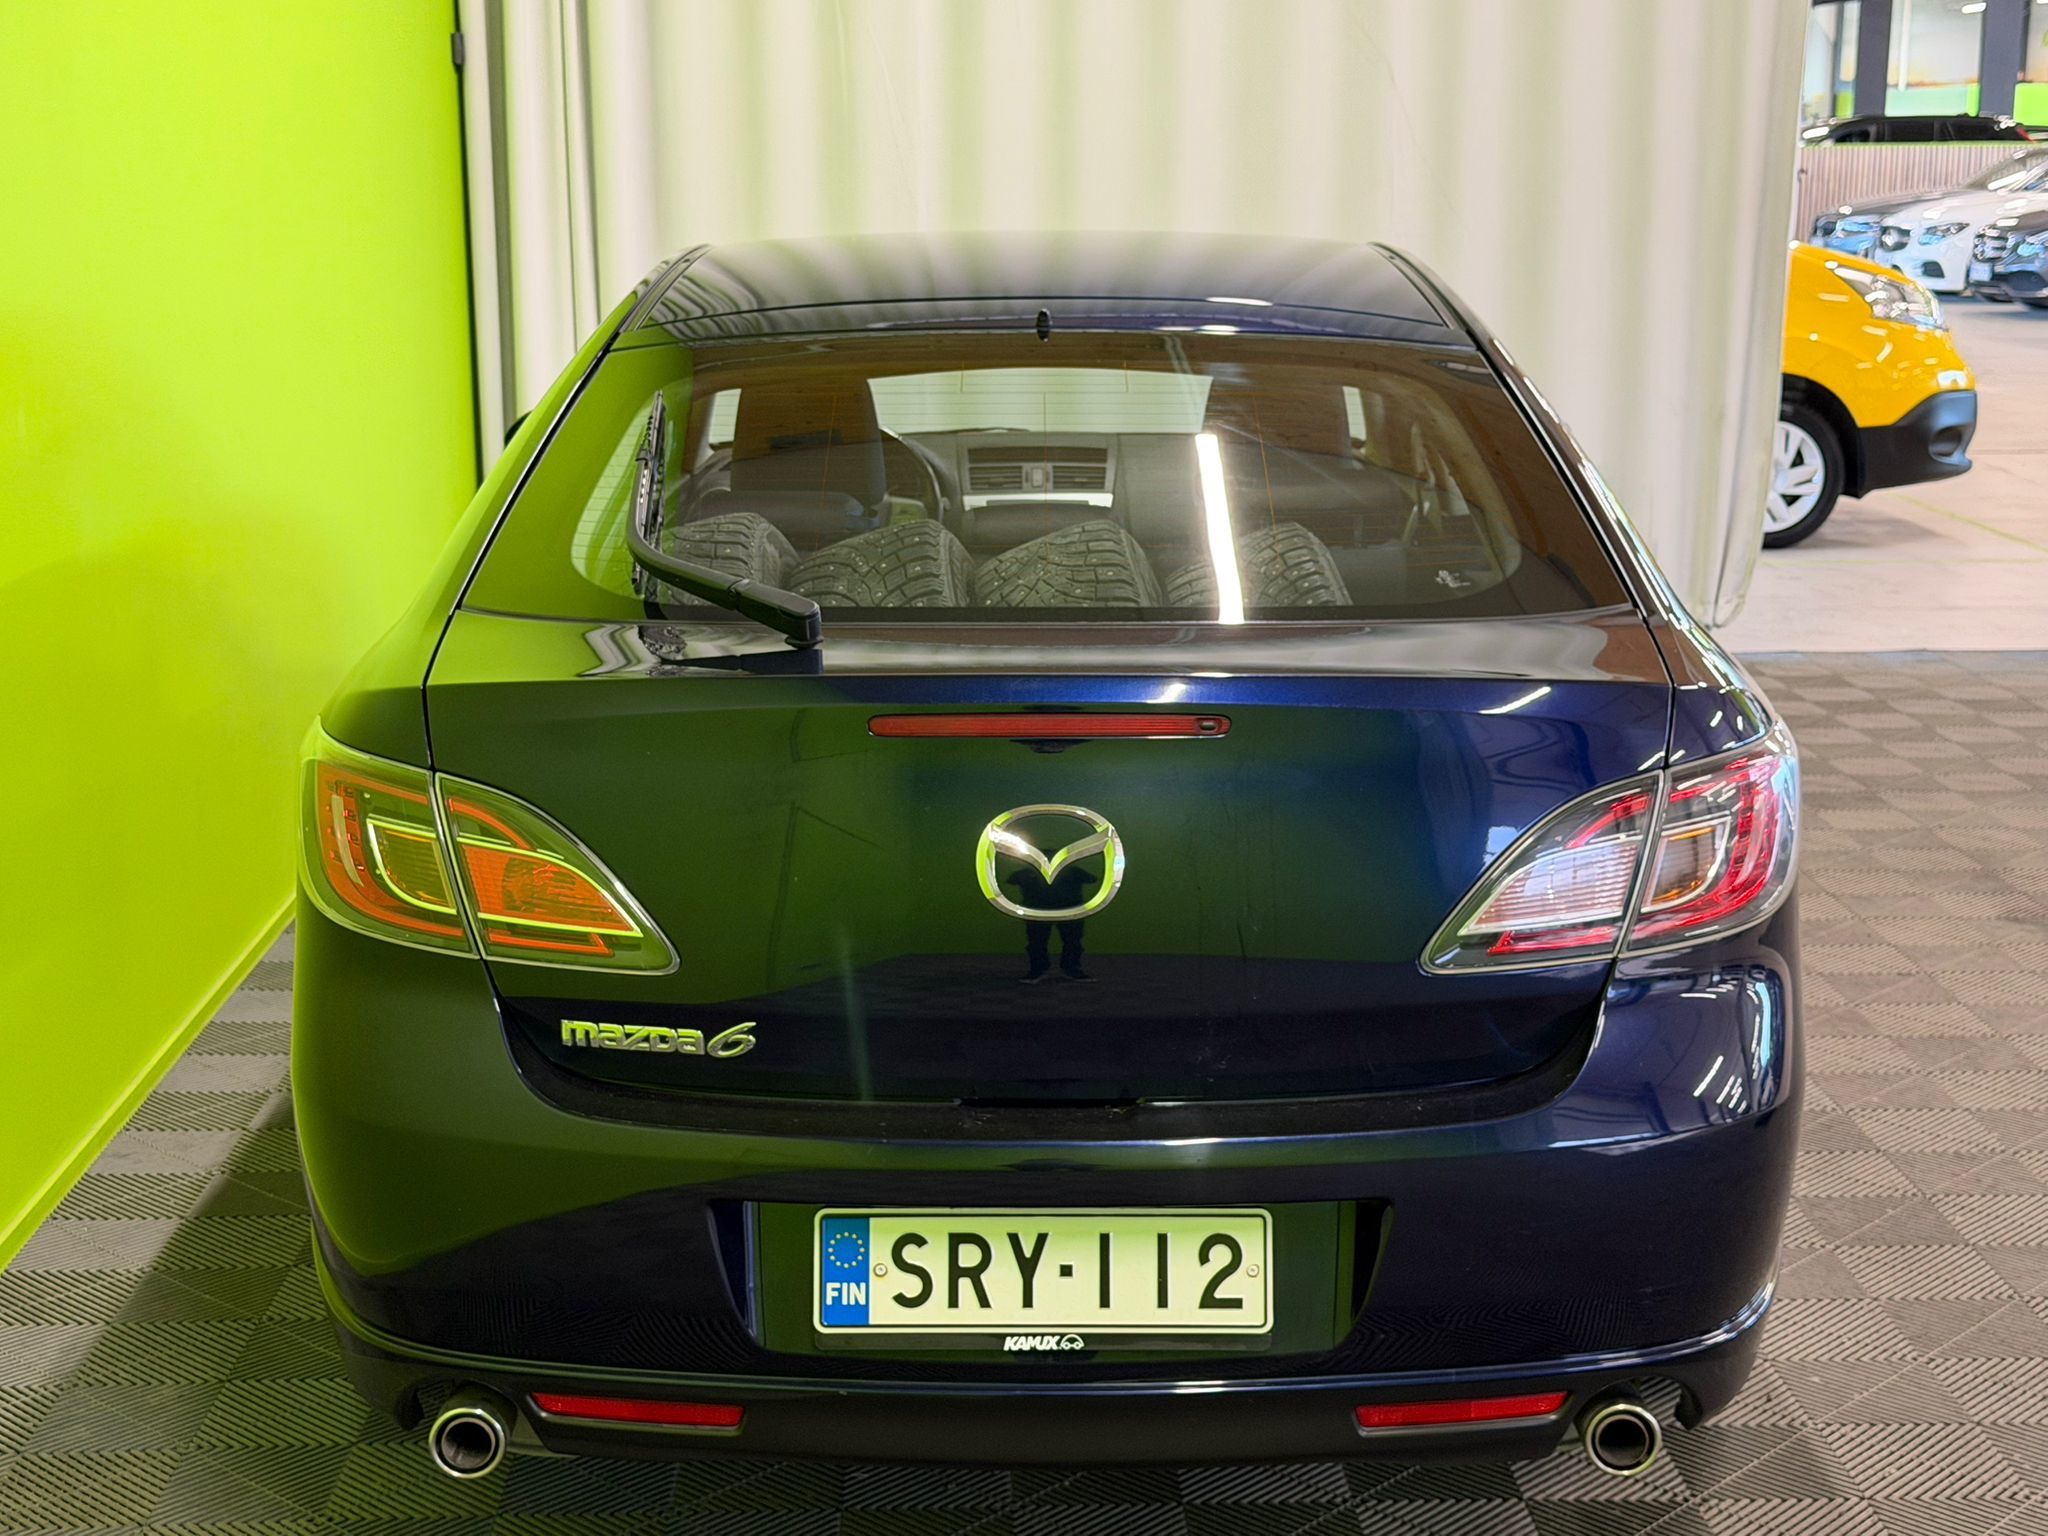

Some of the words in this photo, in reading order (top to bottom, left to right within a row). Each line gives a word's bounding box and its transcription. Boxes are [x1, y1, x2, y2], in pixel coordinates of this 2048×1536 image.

[891, 1232, 1244, 1309] SRY-112
[825, 1282, 867, 1306] FIN
[1003, 1335, 1060, 1351] KAMUX
